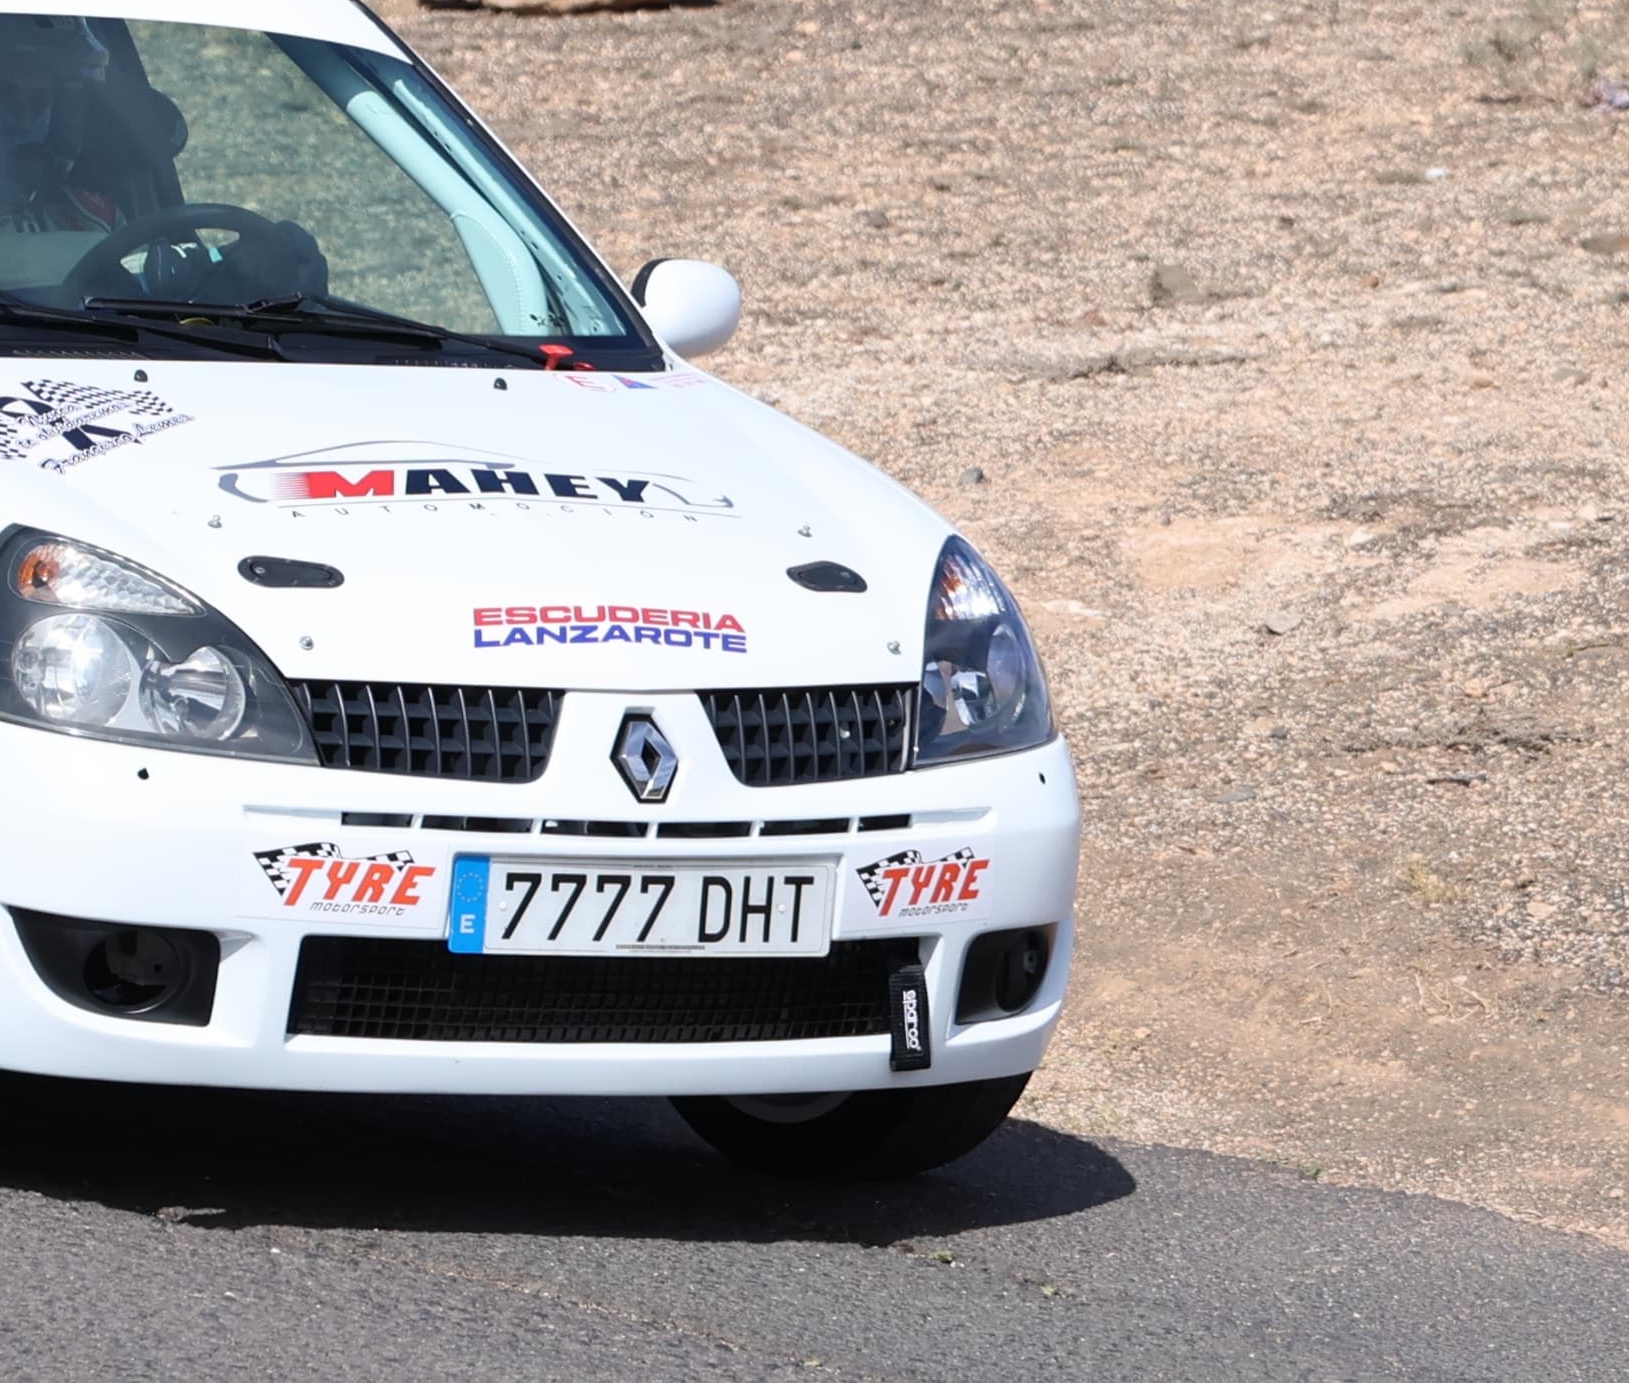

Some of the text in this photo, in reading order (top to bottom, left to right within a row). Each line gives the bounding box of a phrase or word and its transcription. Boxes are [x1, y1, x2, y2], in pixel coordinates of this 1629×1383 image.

[278, 468, 651, 503] MAHEY
[473, 605, 746, 633] ESCUDERIA
[474, 625, 747, 653] LANZAROTE
[283, 857, 437, 907] TYRE
[878, 859, 991, 916] TYRE
[309, 901, 406, 917] motorsport
[459, 873, 814, 944] E 7777 DHT
[898, 902, 969, 918] motorsport
[902, 989, 921, 1051] sparco
